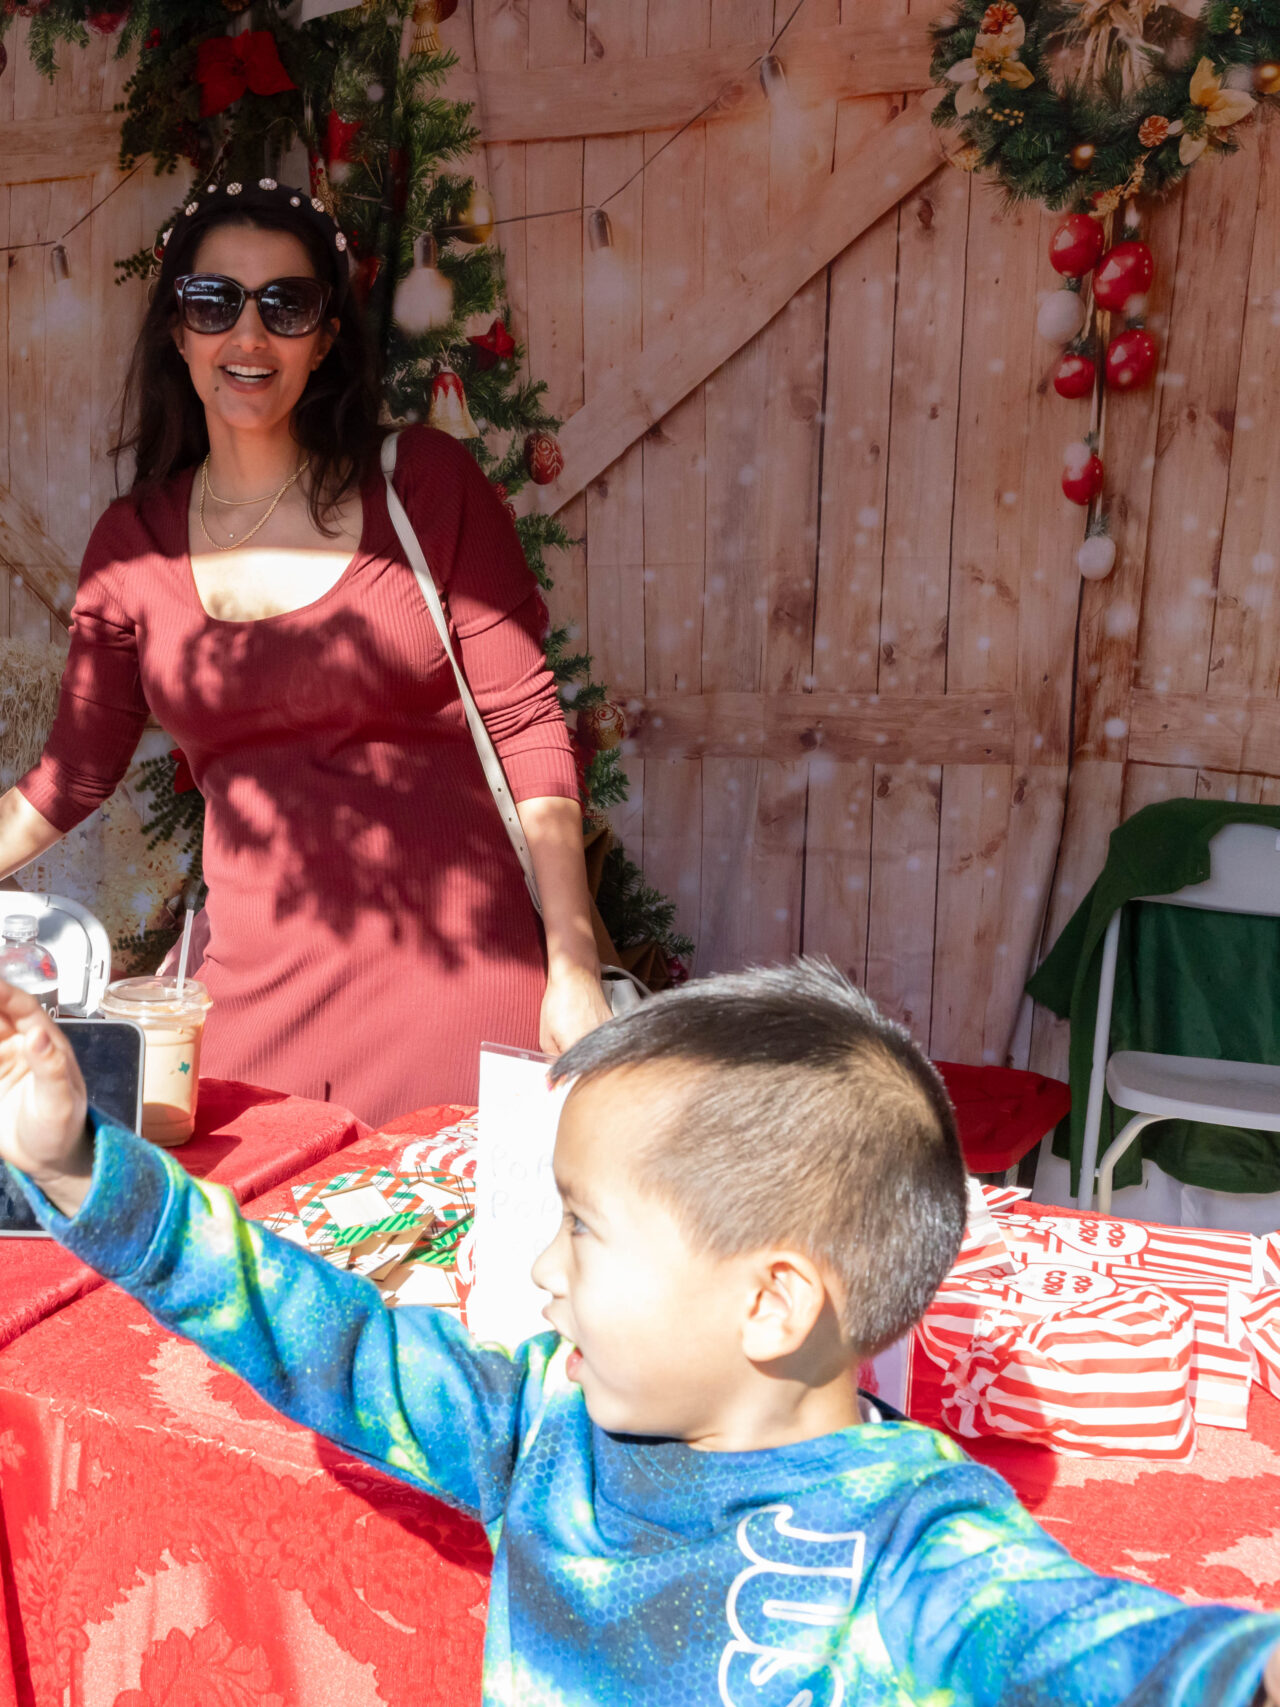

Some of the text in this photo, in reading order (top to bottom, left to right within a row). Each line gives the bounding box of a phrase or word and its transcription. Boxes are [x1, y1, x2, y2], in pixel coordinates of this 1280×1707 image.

[1078, 1219, 1099, 1246] ORN
[1105, 1222, 1126, 1248] POP
[1041, 1270, 1067, 1295] CORN
[1071, 1275, 1094, 1294] POP
